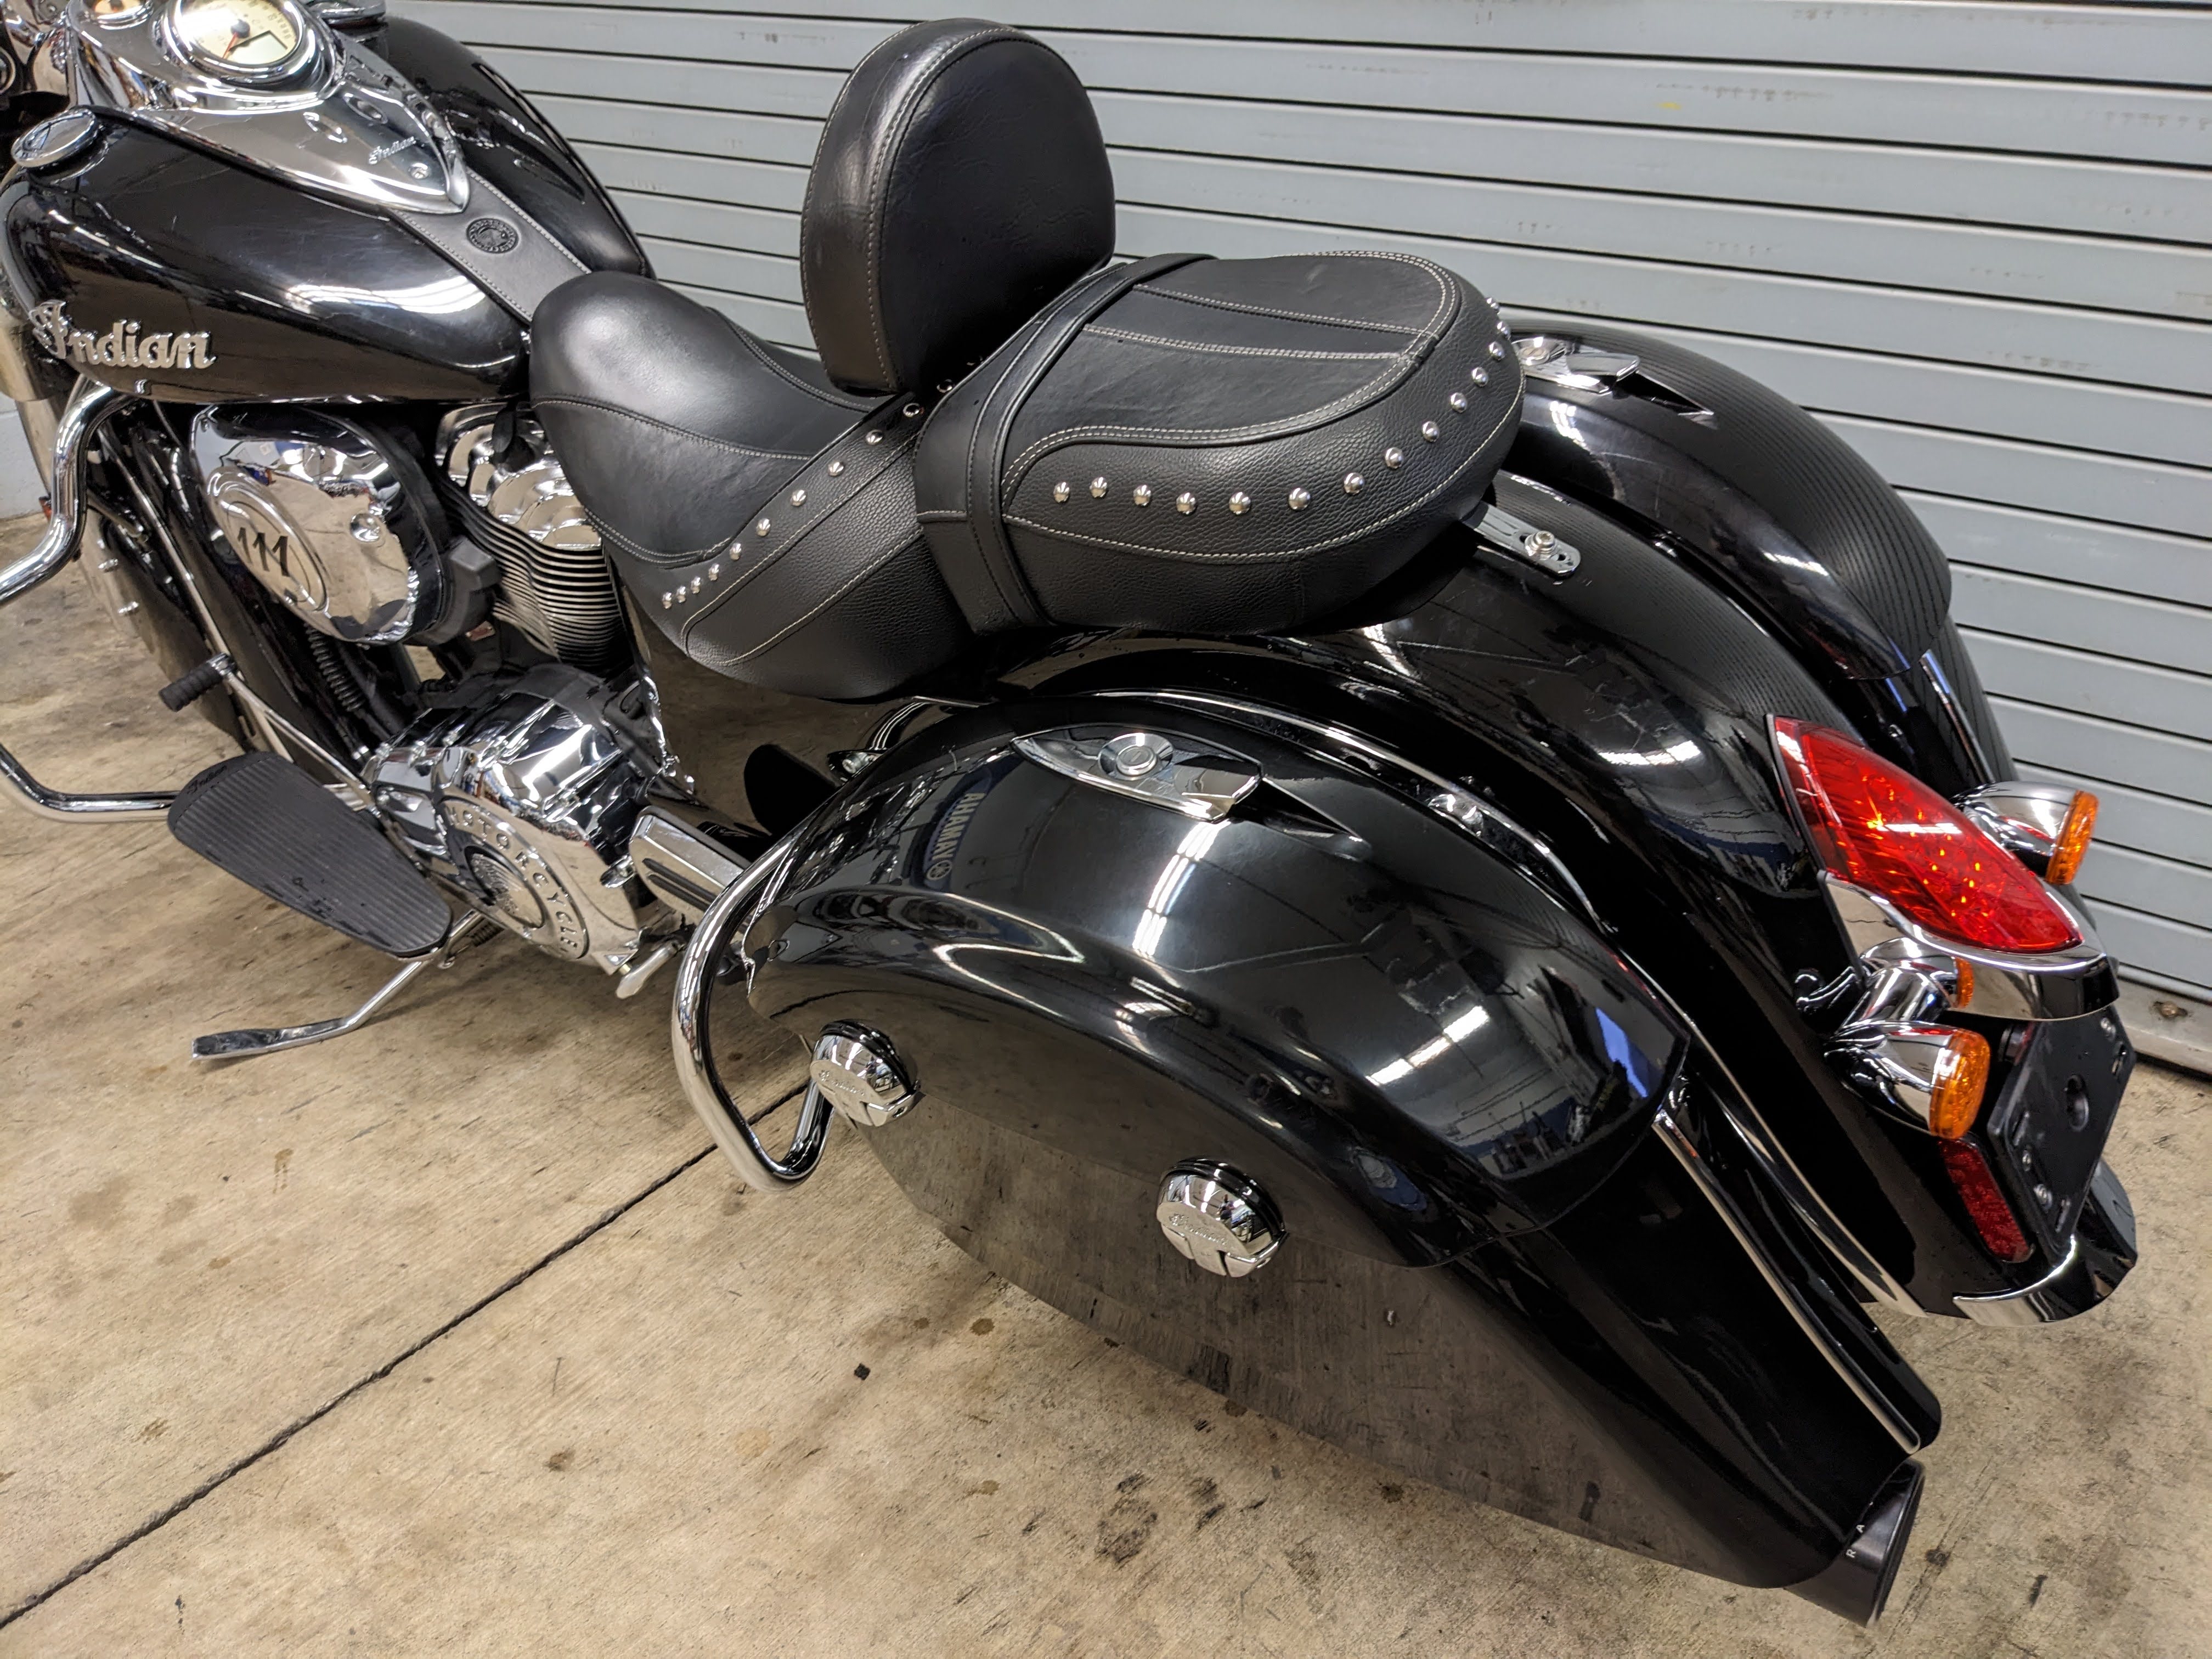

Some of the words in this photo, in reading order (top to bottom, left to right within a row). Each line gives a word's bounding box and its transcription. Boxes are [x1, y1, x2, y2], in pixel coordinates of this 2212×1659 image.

[369, 136, 416, 165] Indian
[29, 300, 217, 369] Indian
[238, 527, 290, 577] 111
[445, 806, 578, 948] MOTORCYCLE
